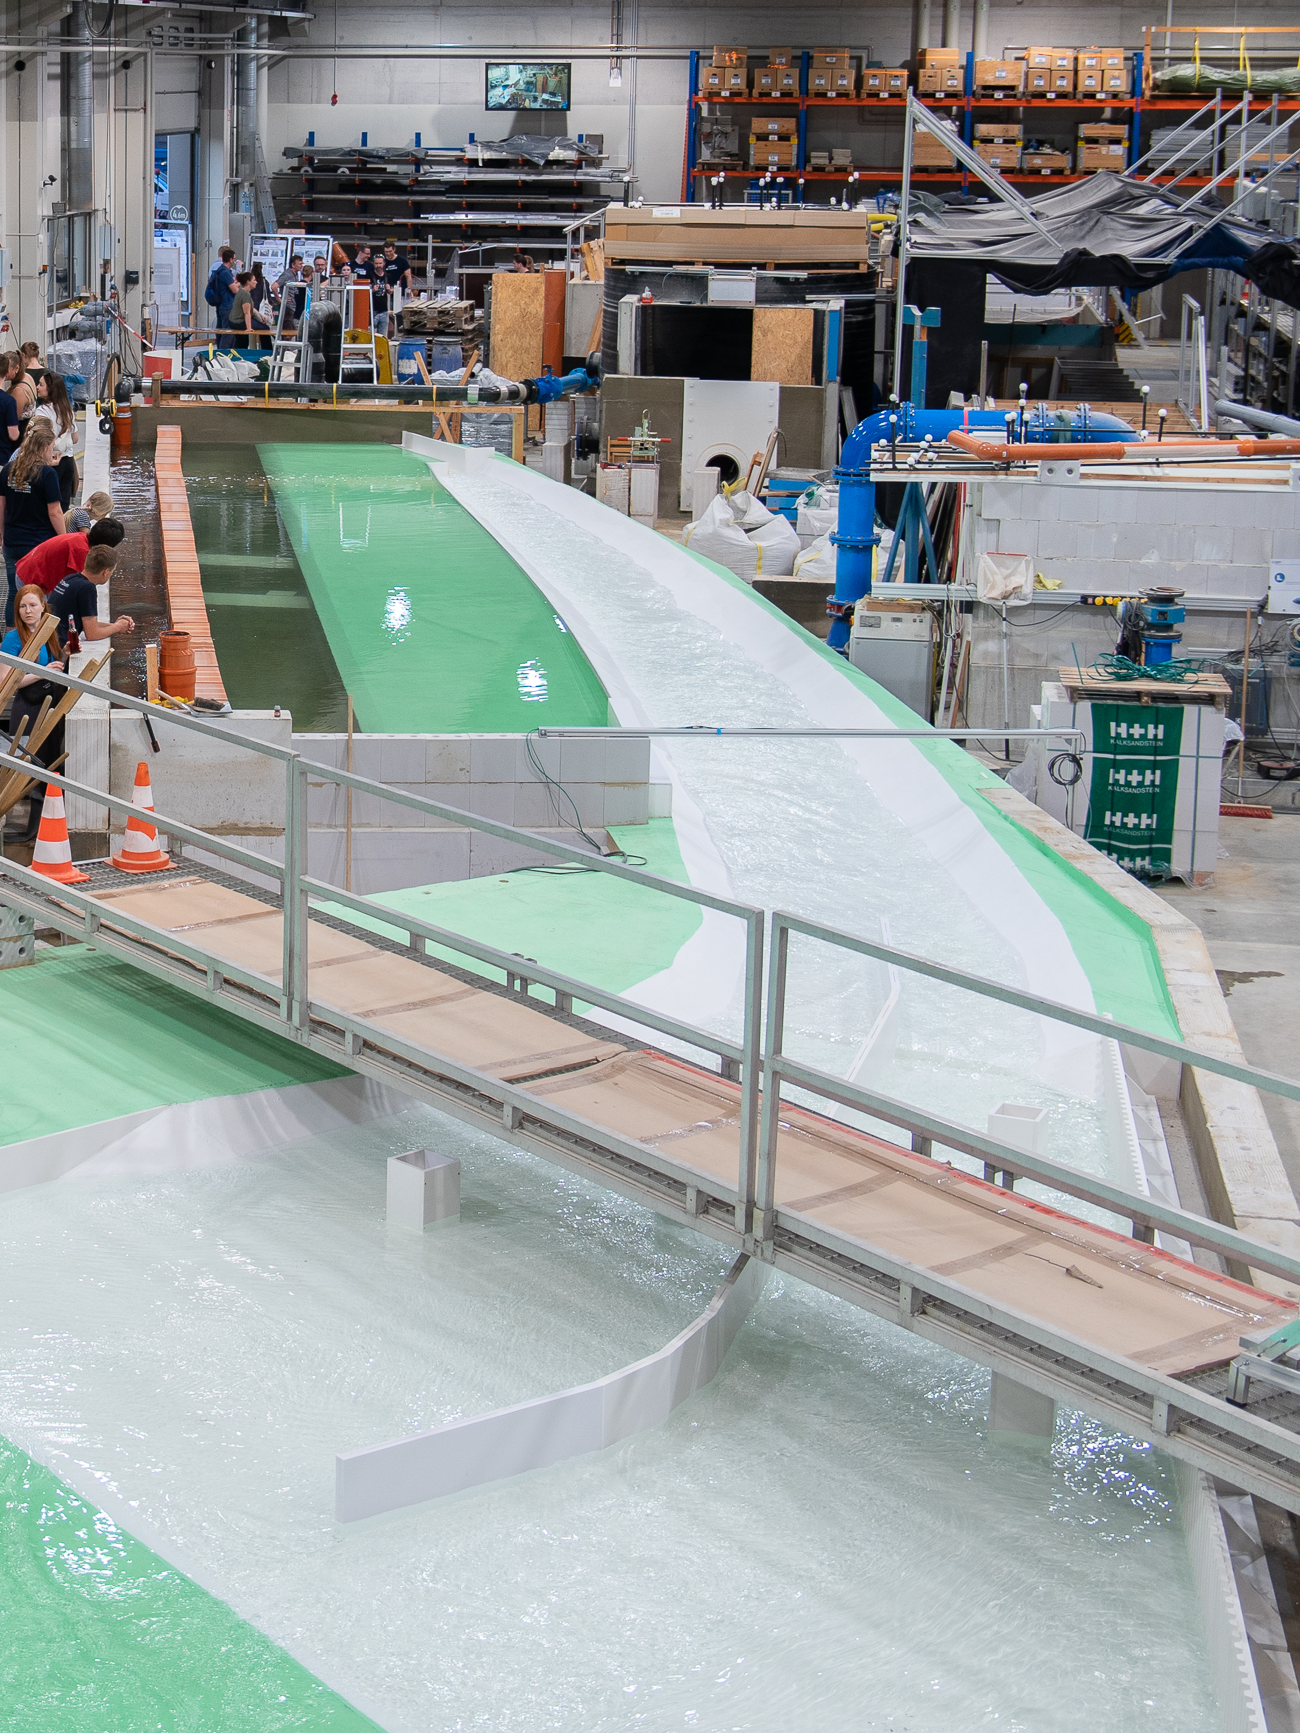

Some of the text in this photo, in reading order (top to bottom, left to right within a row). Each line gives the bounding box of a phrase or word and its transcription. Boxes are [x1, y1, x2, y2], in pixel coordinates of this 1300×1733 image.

[1110, 722, 1164, 740] H+H
[1110, 738, 1164, 747] KALKSANDSTEIN
[1108, 768, 1162, 786] H+H
[1107, 785, 1161, 794] KALKSANDSTEIN
[1104, 810, 1158, 829] H+H
[1103, 826, 1156, 836] KALKSANDSTEIN
